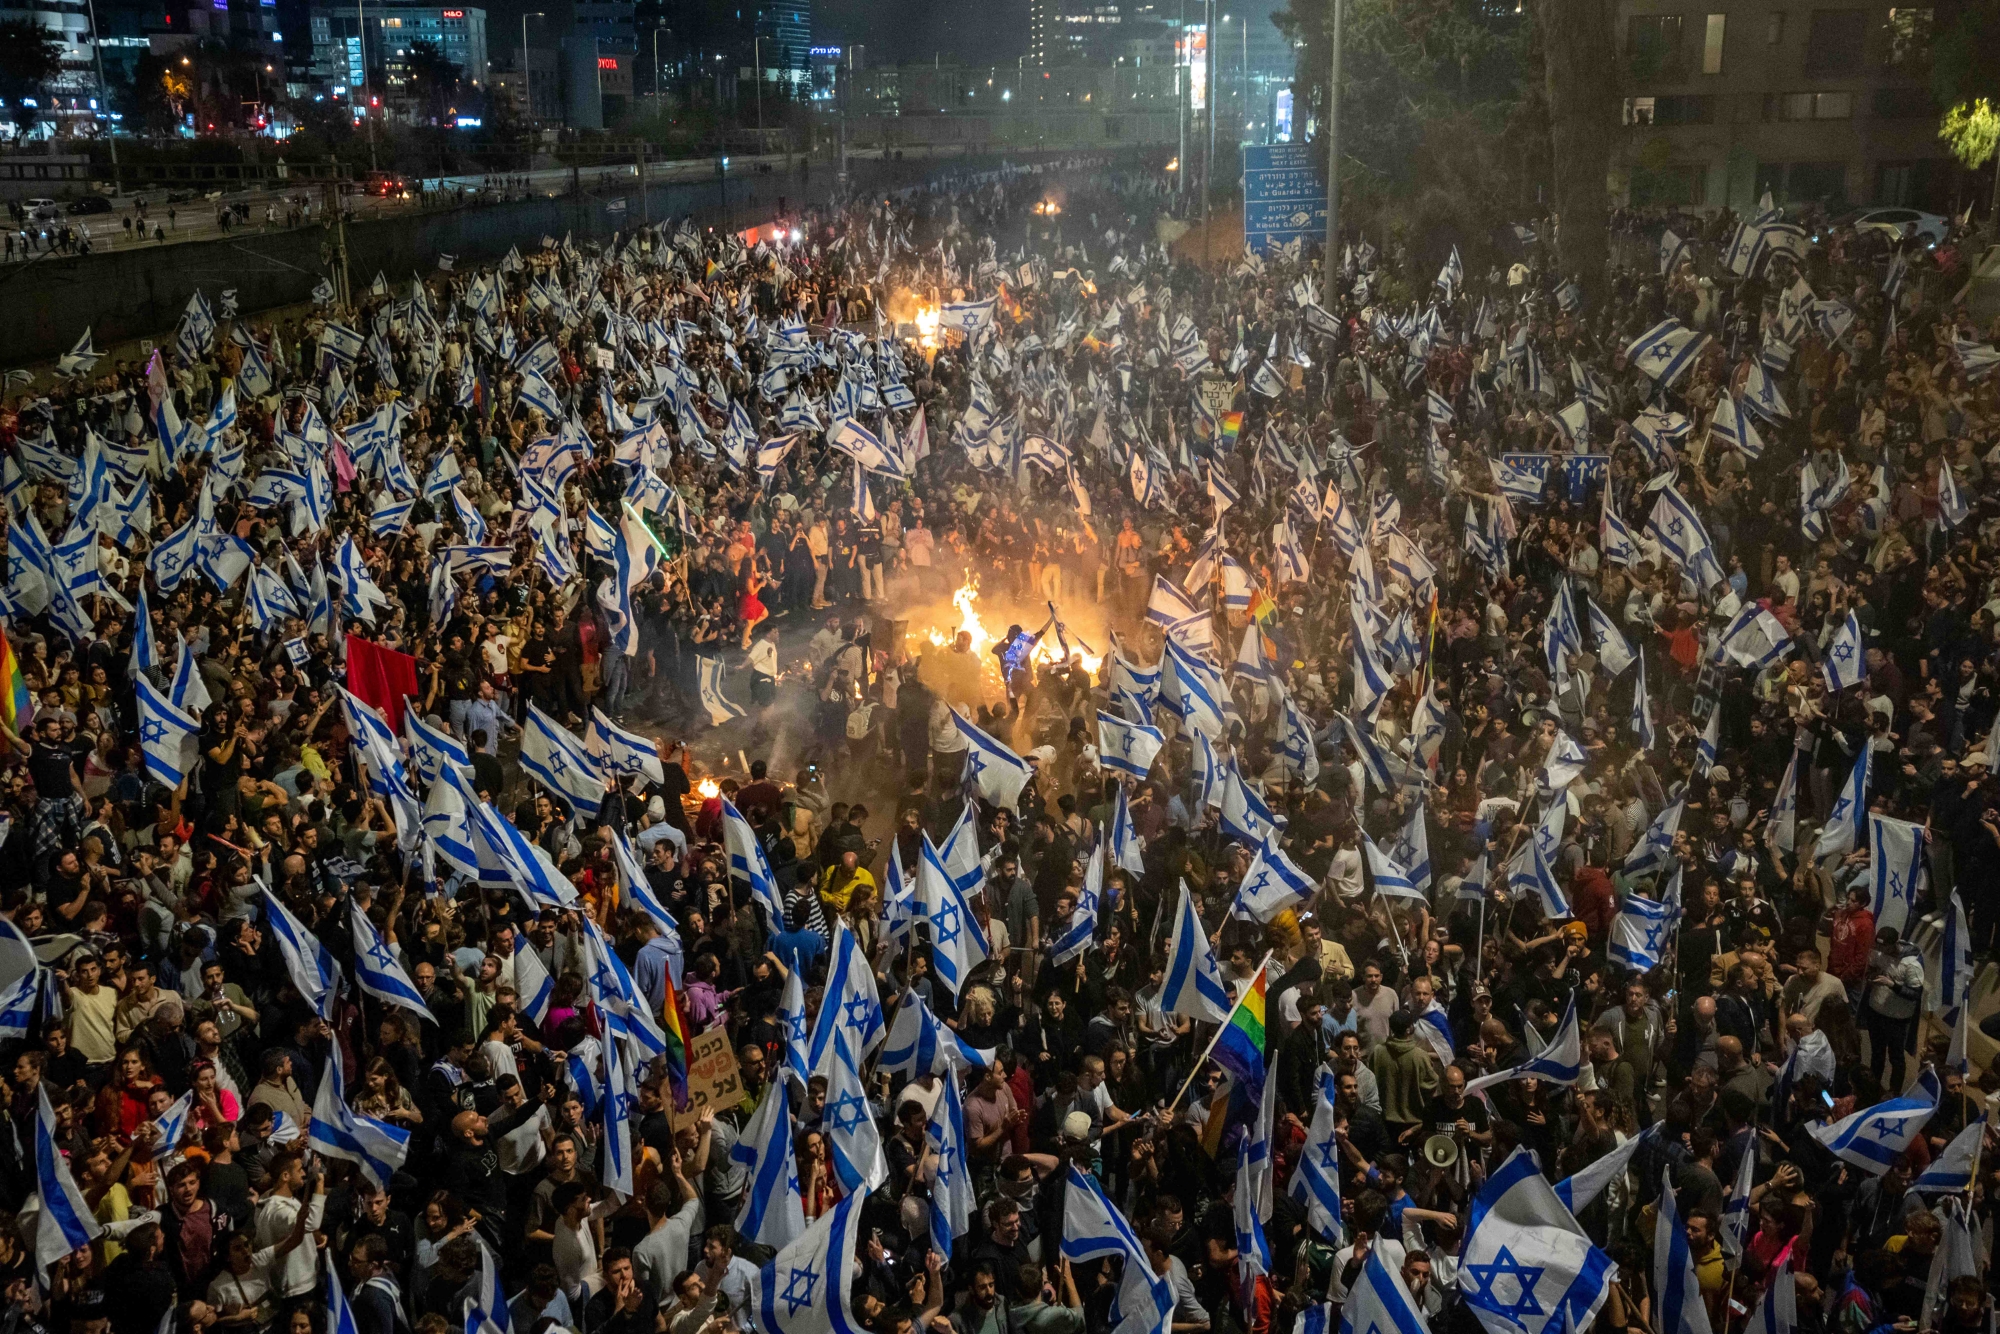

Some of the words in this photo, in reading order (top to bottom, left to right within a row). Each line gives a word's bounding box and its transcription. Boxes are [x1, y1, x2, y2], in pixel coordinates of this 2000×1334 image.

[598, 58, 618, 69] OYOTA
[1271, 188, 1301, 196] Guardia
[1209, 382, 1228, 392] אולי
[1209, 399, 1224, 408] עם
